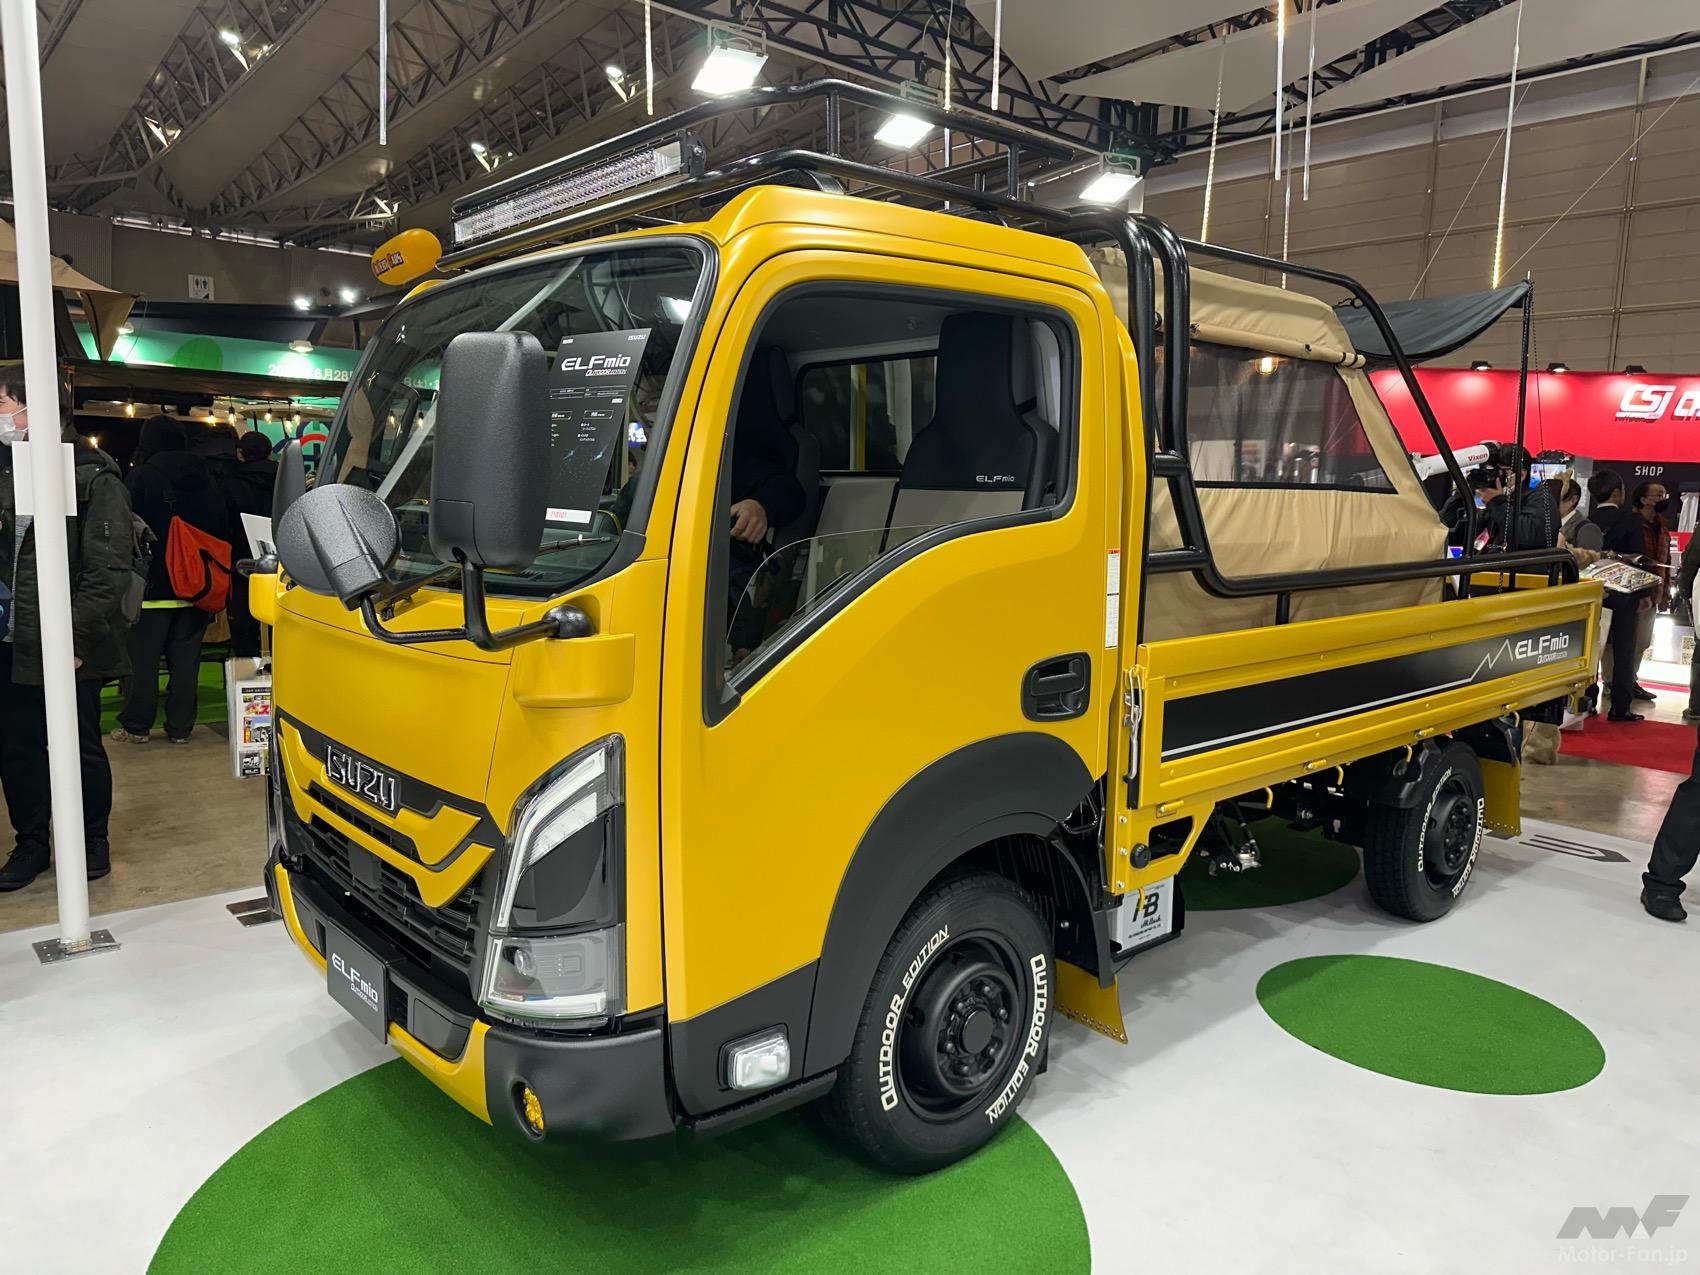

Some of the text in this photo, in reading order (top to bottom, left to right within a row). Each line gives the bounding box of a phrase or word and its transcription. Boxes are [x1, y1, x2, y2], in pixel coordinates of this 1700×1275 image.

[561, 353, 632, 371] ELFmio
[975, 475, 1015, 483] ELFmio
[1467, 452, 1489, 462] Vixen
[1634, 465, 1664, 477] SHOP
[1515, 632, 1569, 659] ELFmio
[326, 745, 395, 811] ISUZU
[1418, 802, 1432, 872] OUTDOOR
[1469, 797, 1485, 863] OUTDOOR
[332, 953, 378, 1004] ELFmio
[879, 925, 950, 1111] OUTDOOR EDITION
[985, 953, 1048, 1124] OUTDOOR EDITION
